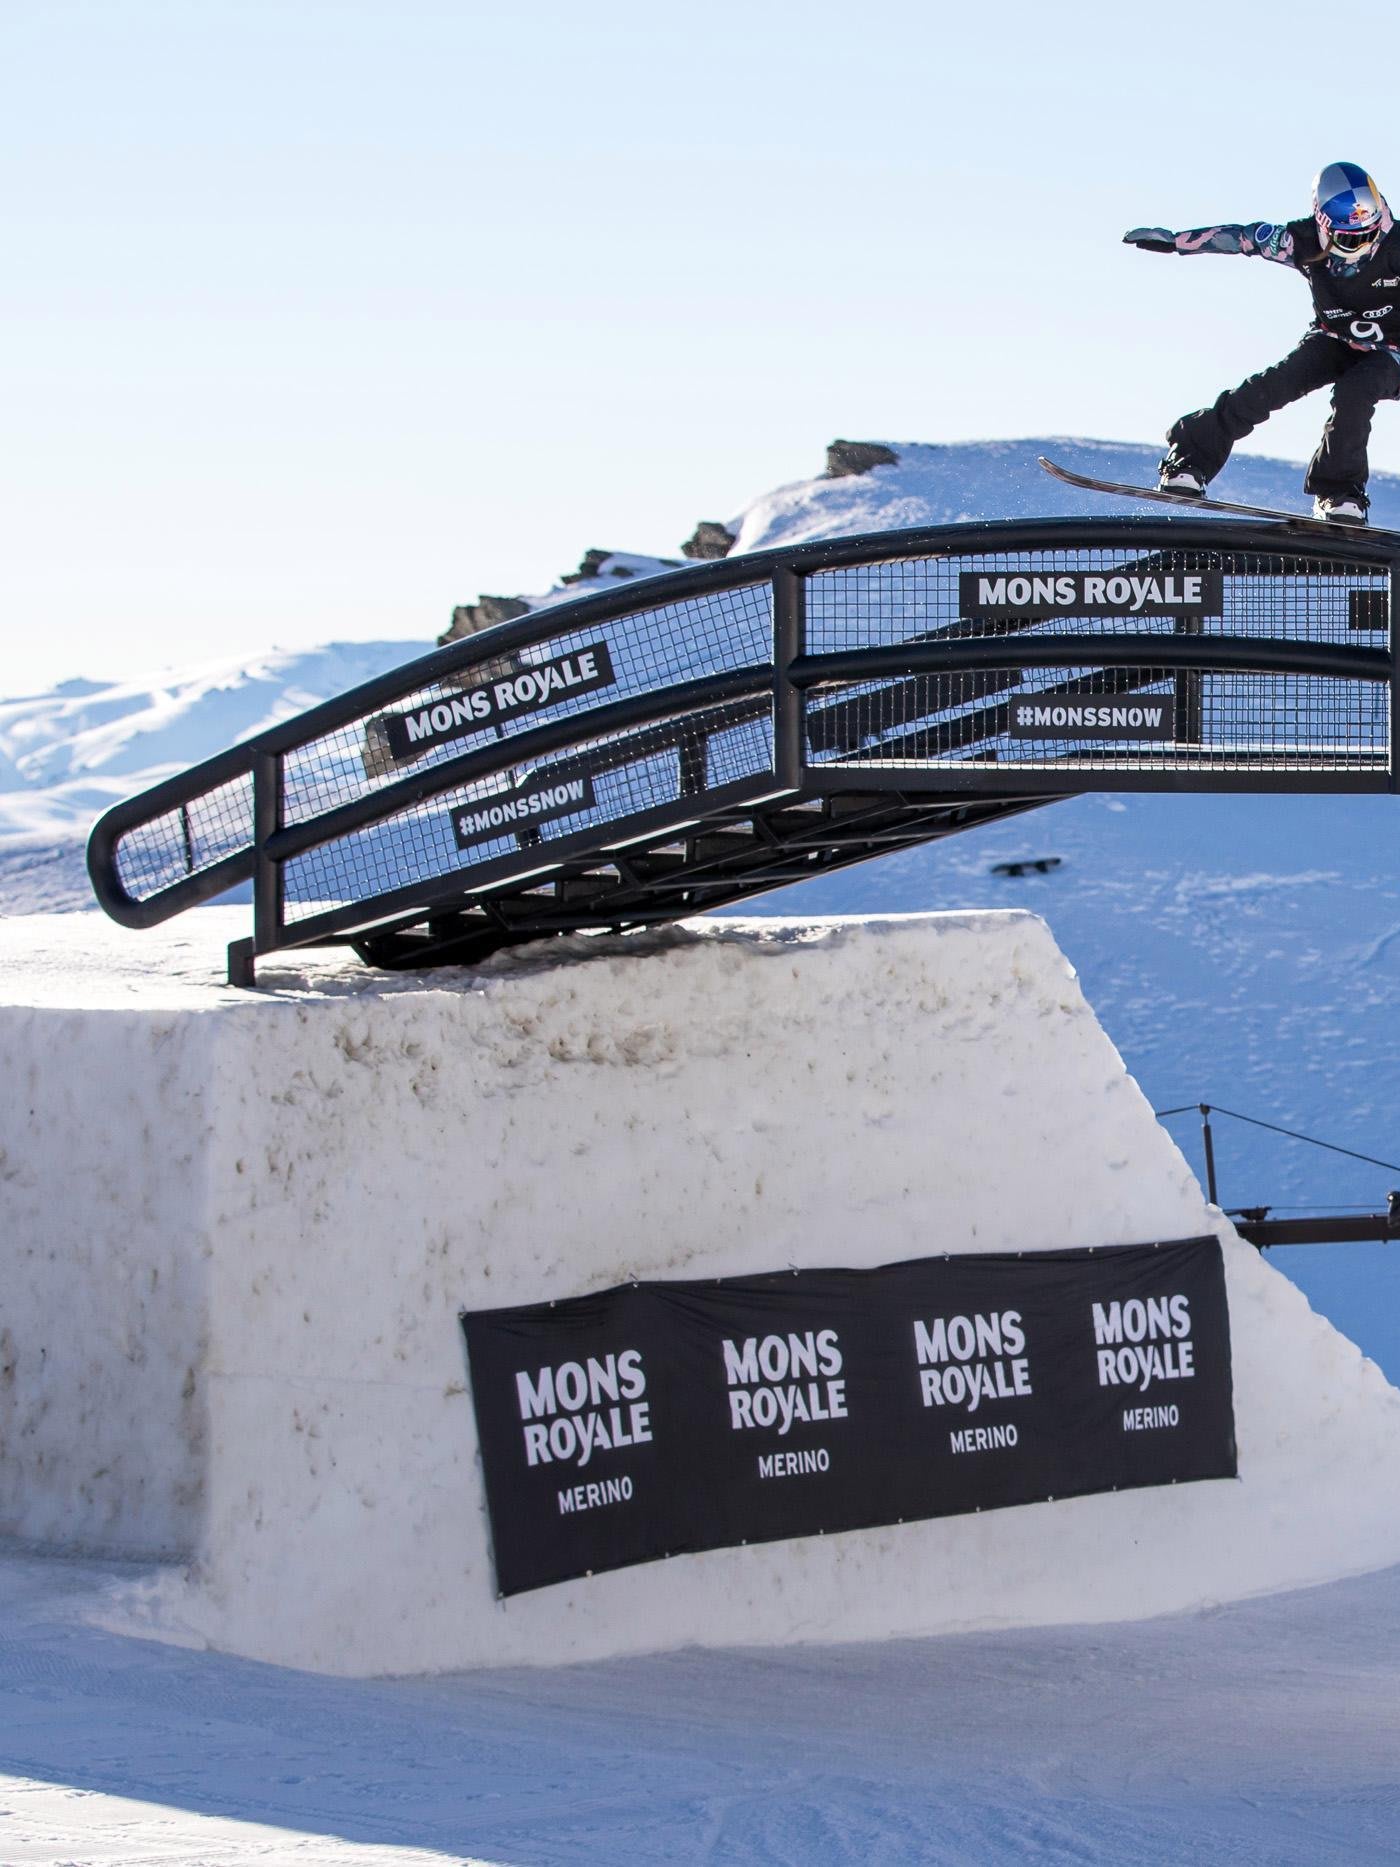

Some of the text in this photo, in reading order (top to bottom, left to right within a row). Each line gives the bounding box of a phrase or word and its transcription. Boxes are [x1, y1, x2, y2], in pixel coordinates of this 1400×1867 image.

[1350, 320, 1384, 342] 9
[978, 576, 1202, 611] MONS ROYALE
[404, 651, 599, 742] MONS ROYALE
[1016, 706, 1163, 728] #MONSSNOW
[459, 779, 584, 836] #MONSSNOW
[913, 1310, 1026, 1365] MONS
[1091, 1294, 1191, 1345] MONS
[722, 1329, 843, 1385] MONS
[1096, 1341, 1195, 1392] ROYALE
[515, 1349, 646, 1420] MONS
[728, 1379, 849, 1435] ROYALE
[919, 1358, 1033, 1412] ROYALE
[523, 1402, 653, 1467] ROYALE
[950, 1423, 1018, 1454] MERINO
[1123, 1404, 1179, 1432] MERINO
[758, 1448, 830, 1479] MERINO
[558, 1476, 633, 1514] MERINO
